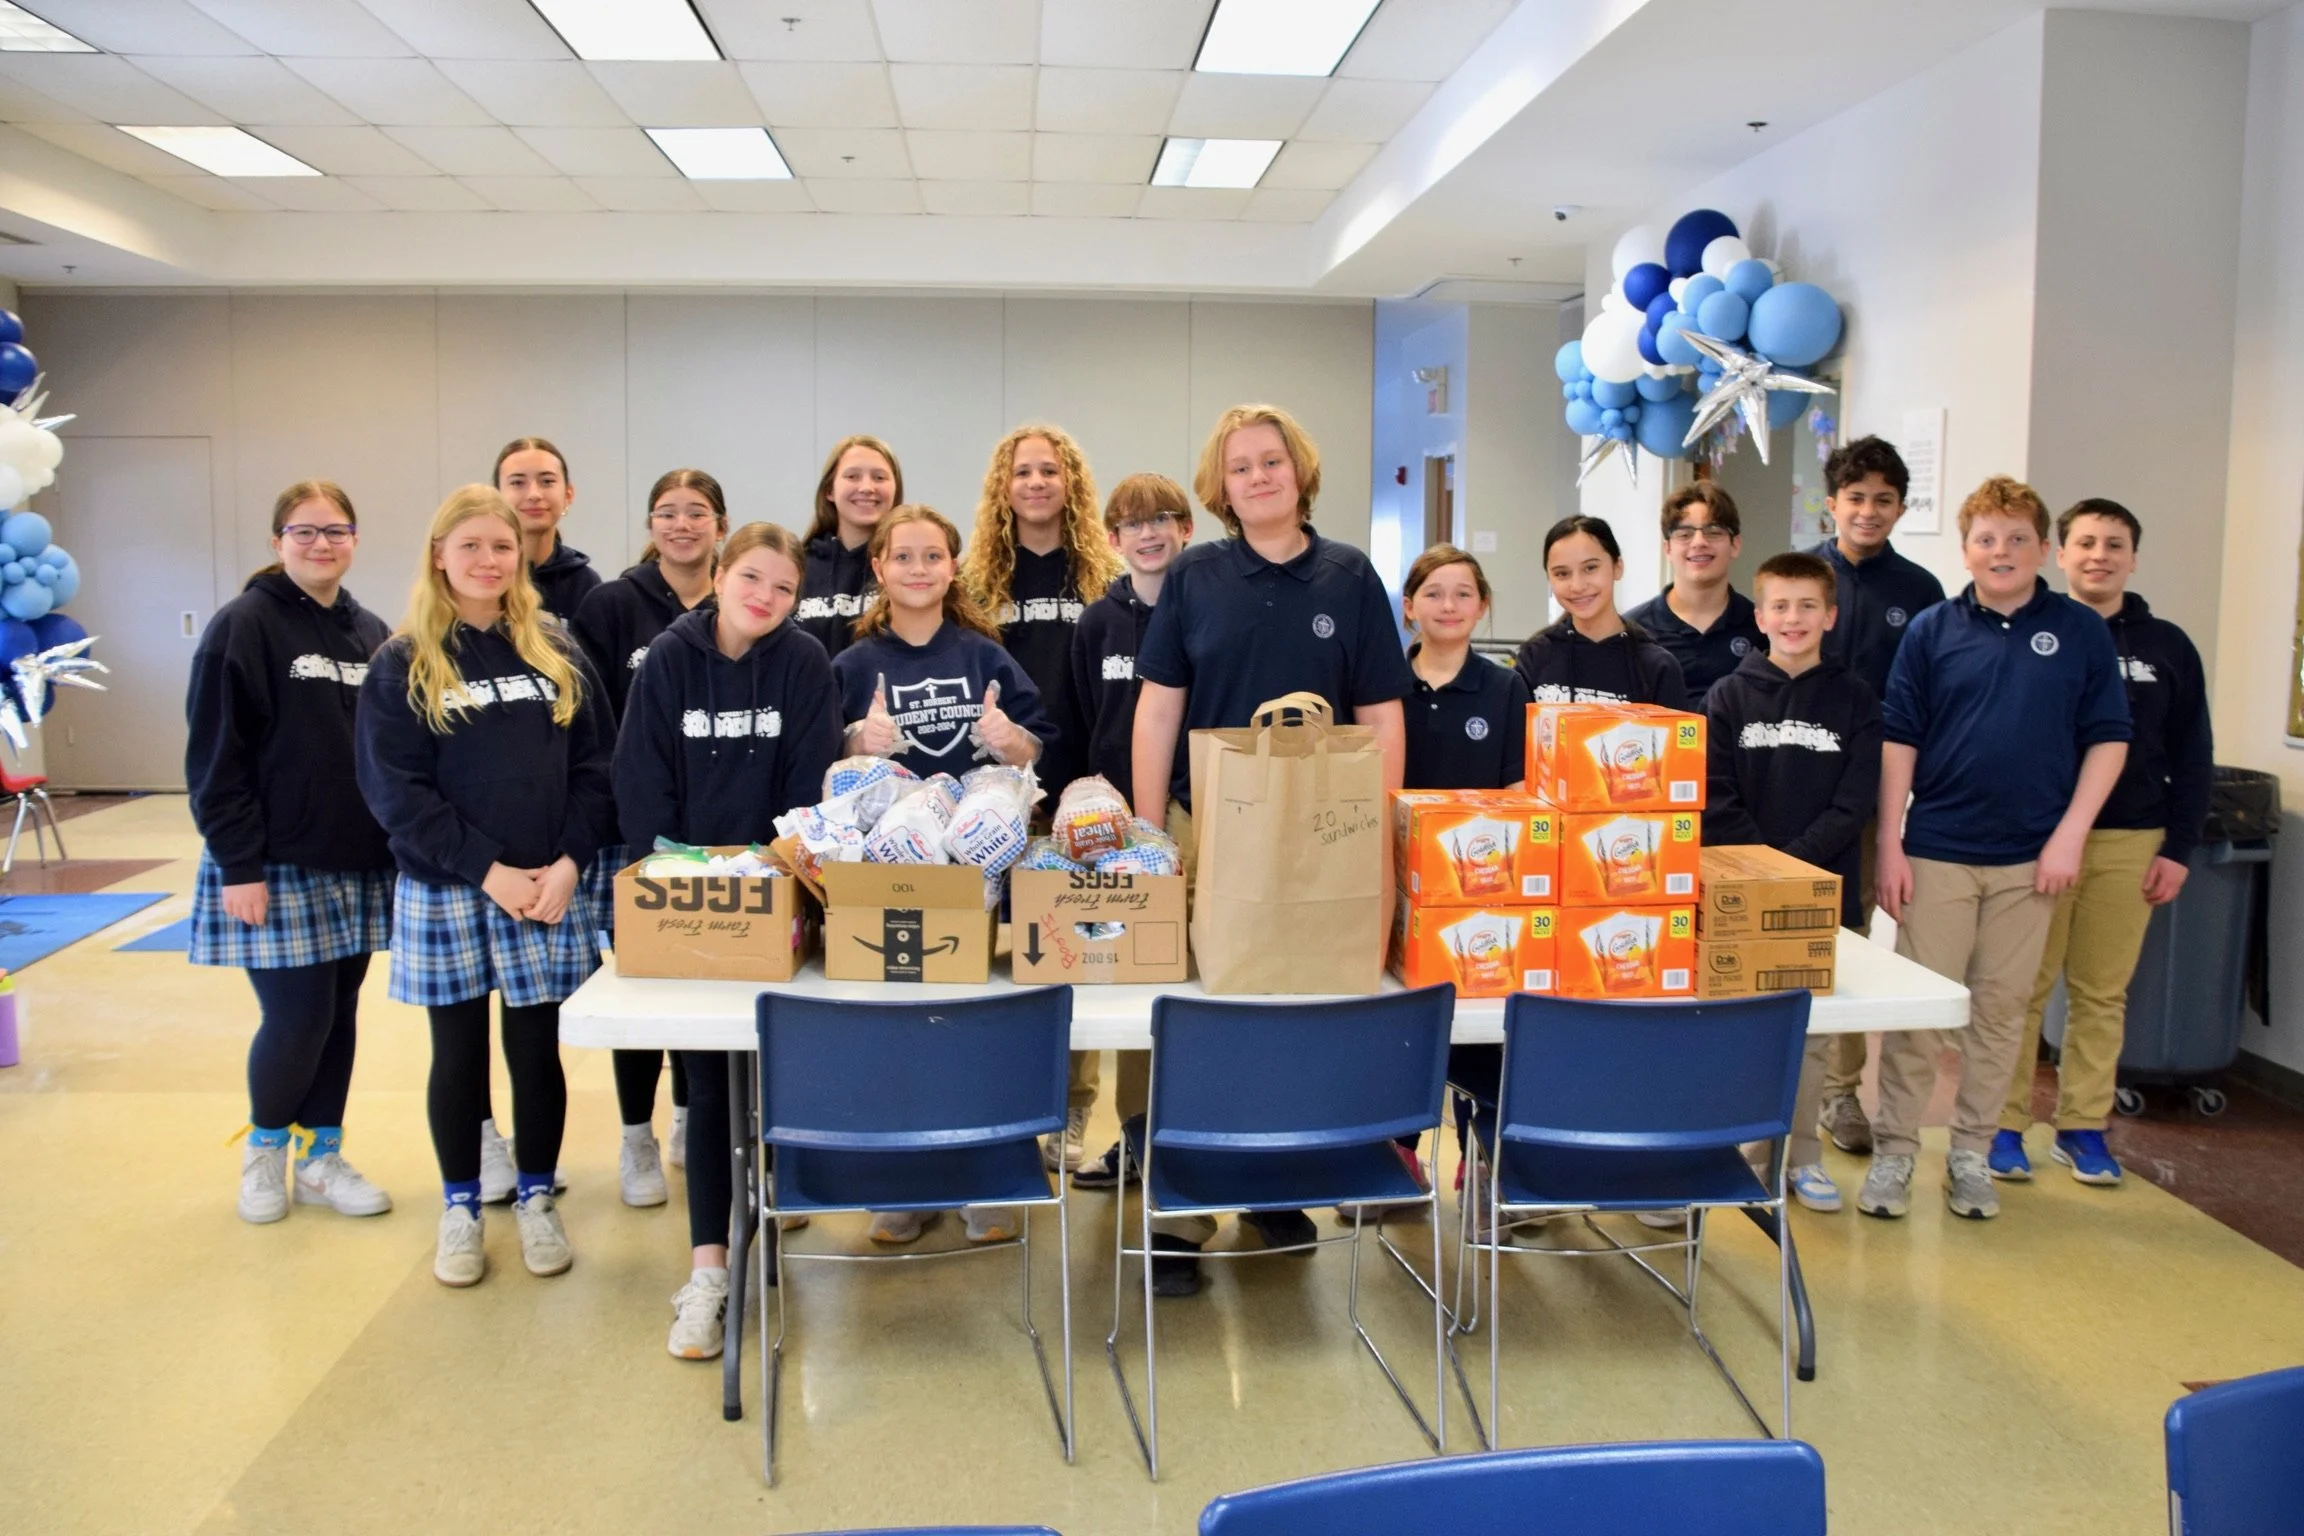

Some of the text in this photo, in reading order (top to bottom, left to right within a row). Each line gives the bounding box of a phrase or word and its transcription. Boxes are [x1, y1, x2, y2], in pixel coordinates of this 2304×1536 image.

[909, 700, 922, 709] ST.
[917, 721, 956, 734] 2023-2024
[1679, 726, 1696, 738] 30
[1313, 810, 1337, 833] 20
[1532, 821, 1549, 833] 30
[1675, 819, 1691, 831] 30
[964, 824, 1002, 856] Whole Grain
[1072, 822, 1115, 840] Wheat
[970, 832, 1009, 864] White
[1070, 871, 1133, 889] EGGS
[634, 877, 773, 915] EGGS
[1054, 893, 1149, 911] Farm Fresh
[657, 919, 750, 938] Farm Fresh
[1534, 916, 1550, 928] 30
[1672, 915, 1688, 927] 30
